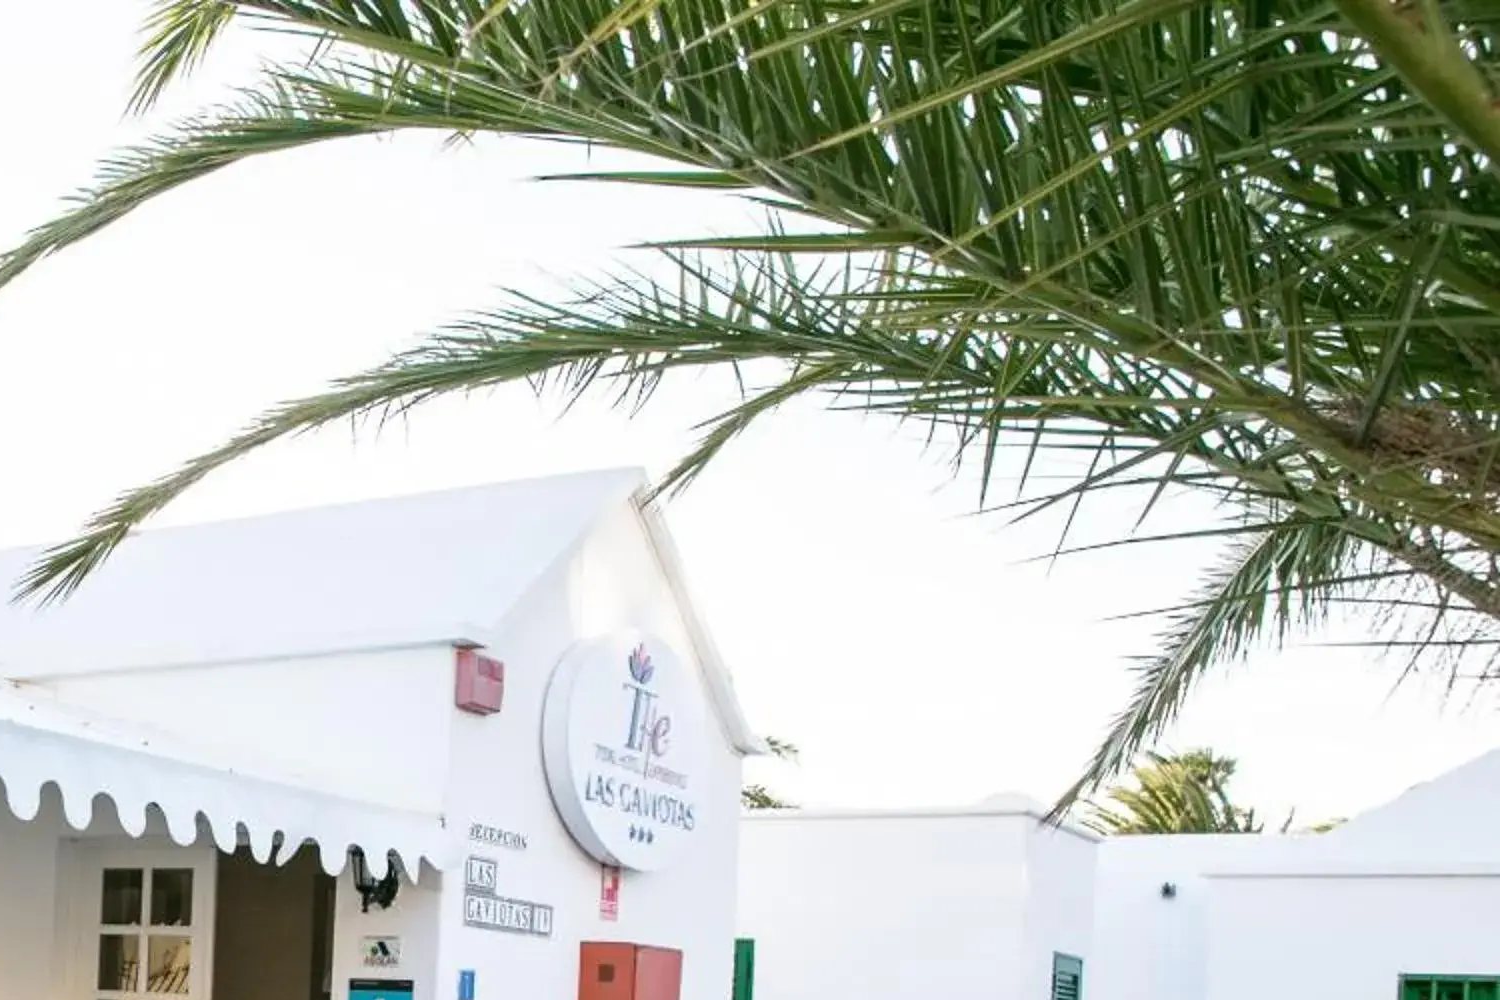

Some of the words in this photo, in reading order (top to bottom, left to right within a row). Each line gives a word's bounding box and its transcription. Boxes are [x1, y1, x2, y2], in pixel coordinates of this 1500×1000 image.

[585, 772, 615, 807] LAS
[619, 783, 695, 831] GAVIOTAS
[468, 861, 493, 885] LAS
[467, 898, 531, 929] GAVIOTAS
